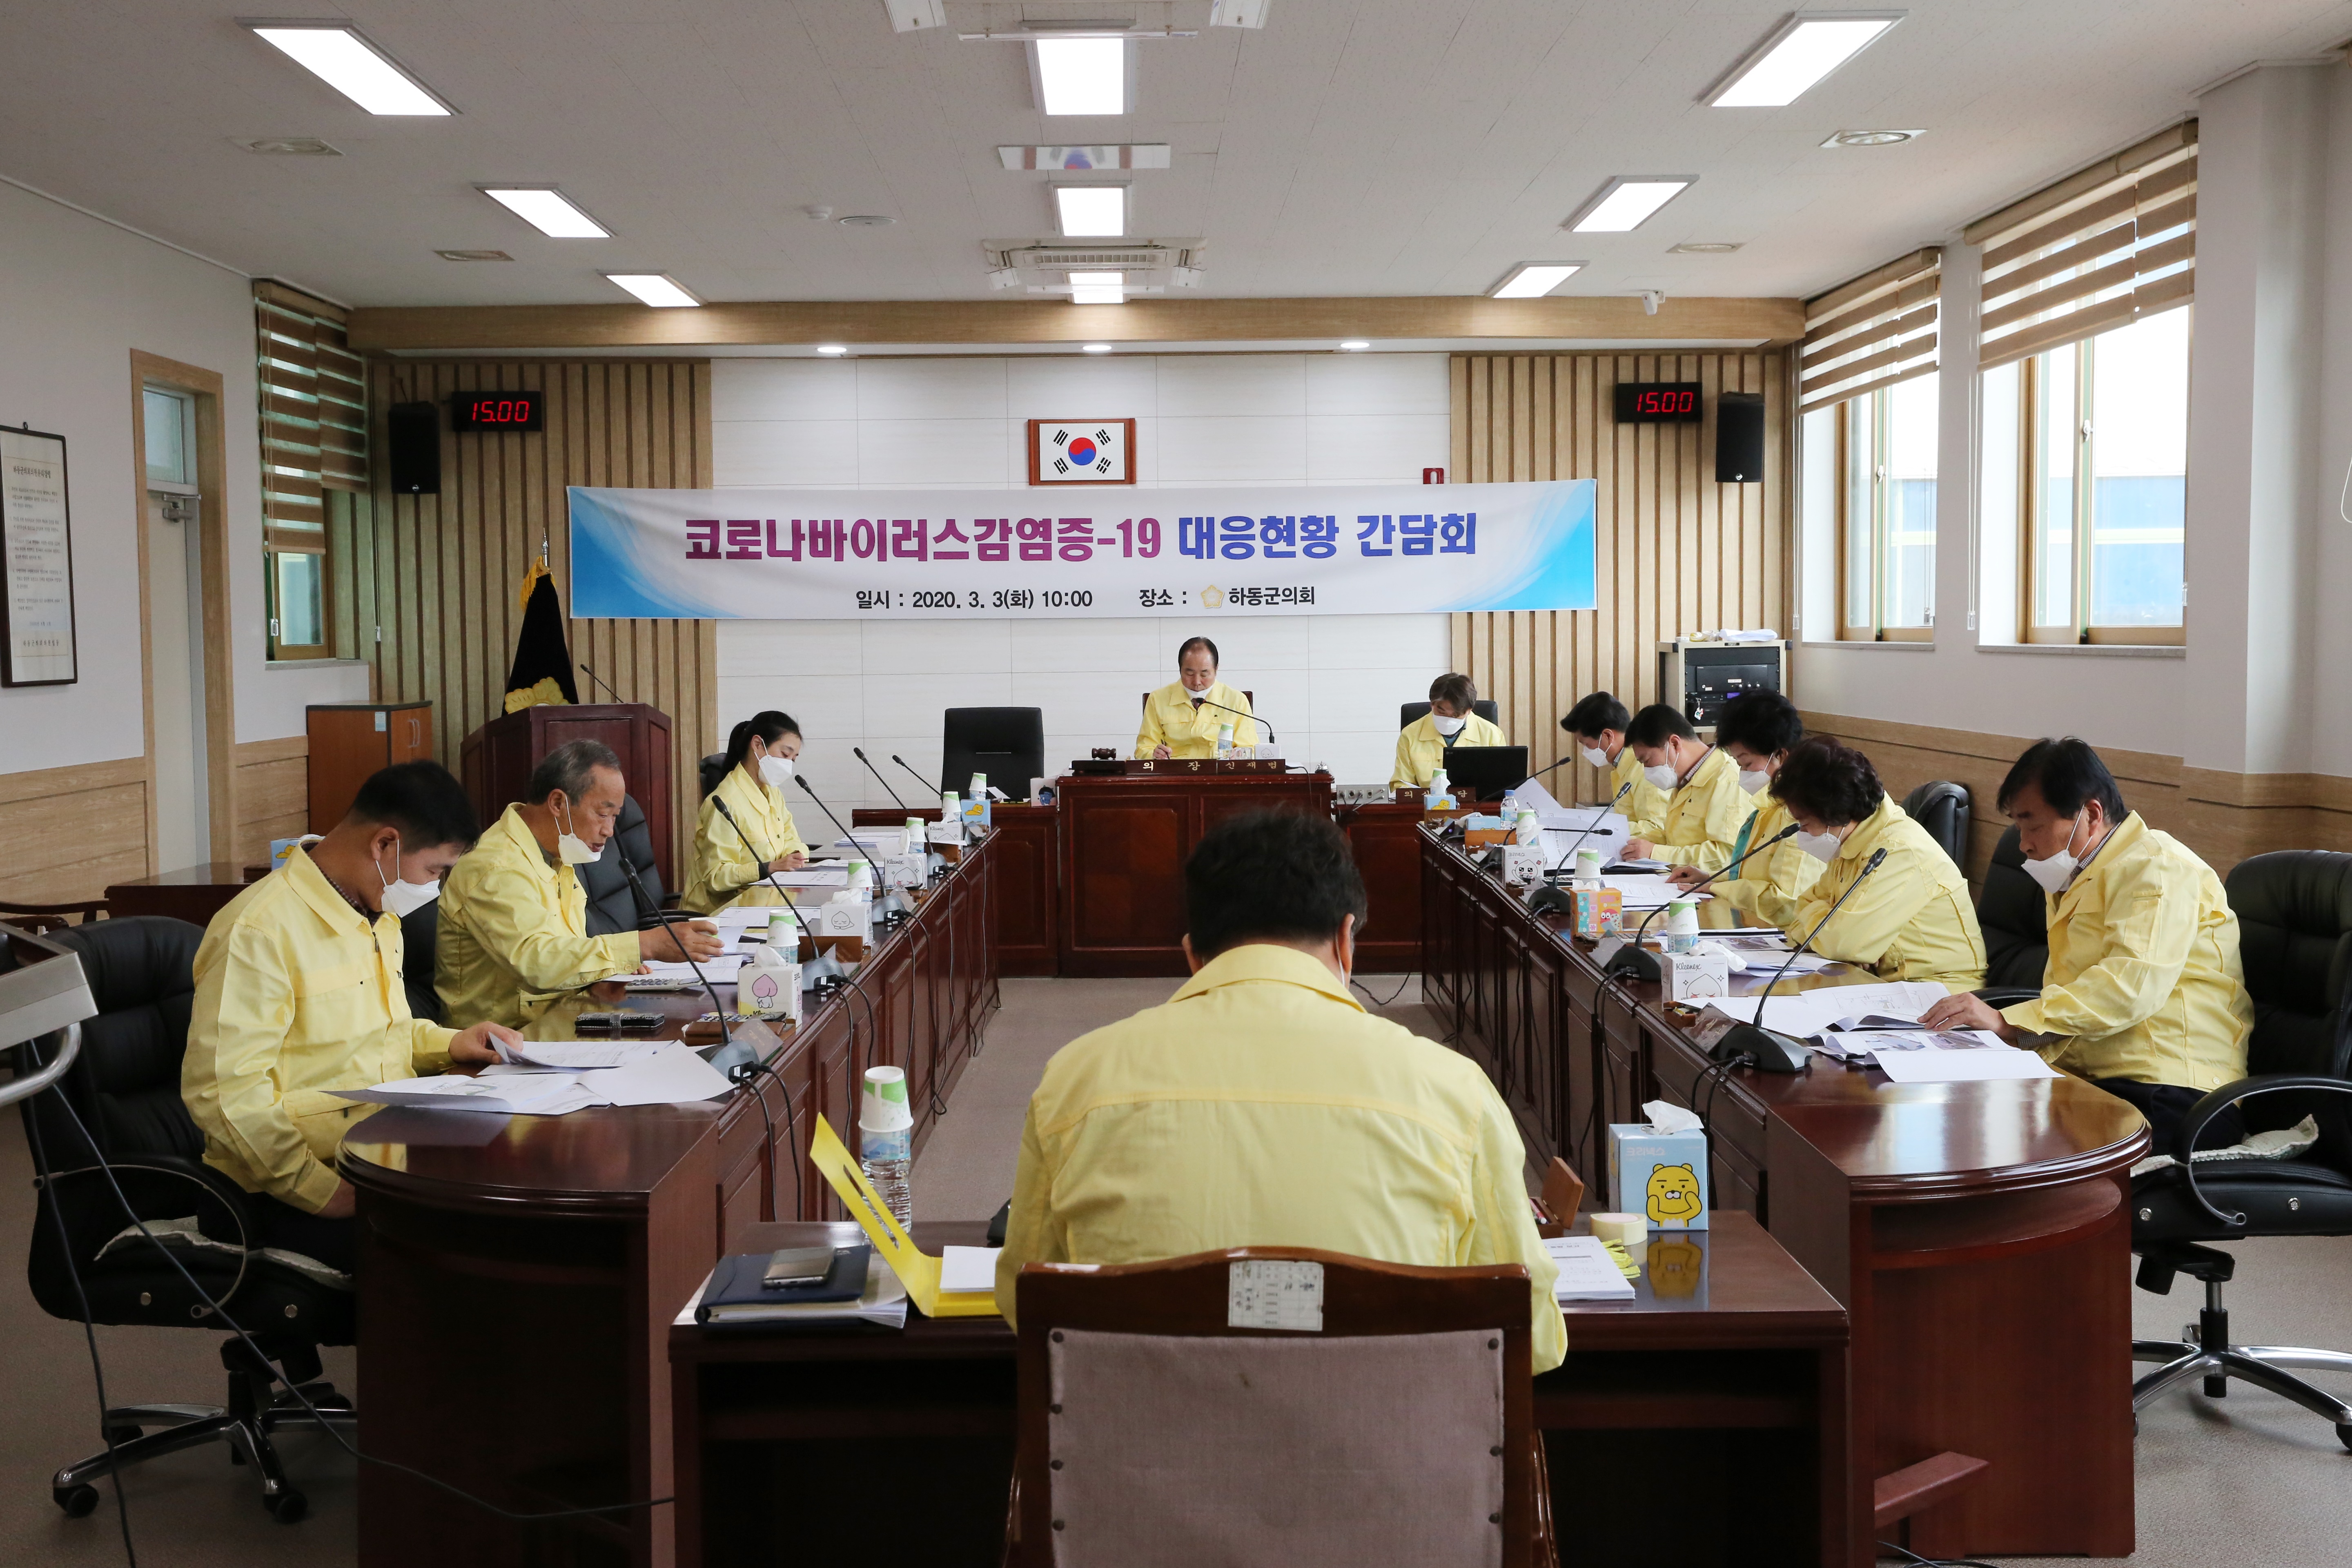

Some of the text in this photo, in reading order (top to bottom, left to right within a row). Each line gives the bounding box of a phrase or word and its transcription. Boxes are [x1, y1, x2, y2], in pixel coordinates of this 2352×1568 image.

[687, 512, 1477, 561] 코로나바이러스감염증-19 대응현황 간담회
[856, 590, 890, 609] 일시
[913, 591, 961, 608] 2020.
[969, 591, 984, 608] 3.
[993, 589, 1034, 610] 3(화)
[1042, 590, 1092, 607] 10:00
[1139, 589, 1174, 607] 장소
[1229, 586, 1314, 606] 하동군의회
[1676, 962, 1702, 971] Kleenex
[1626, 1147, 1666, 1156] 크리넥스
